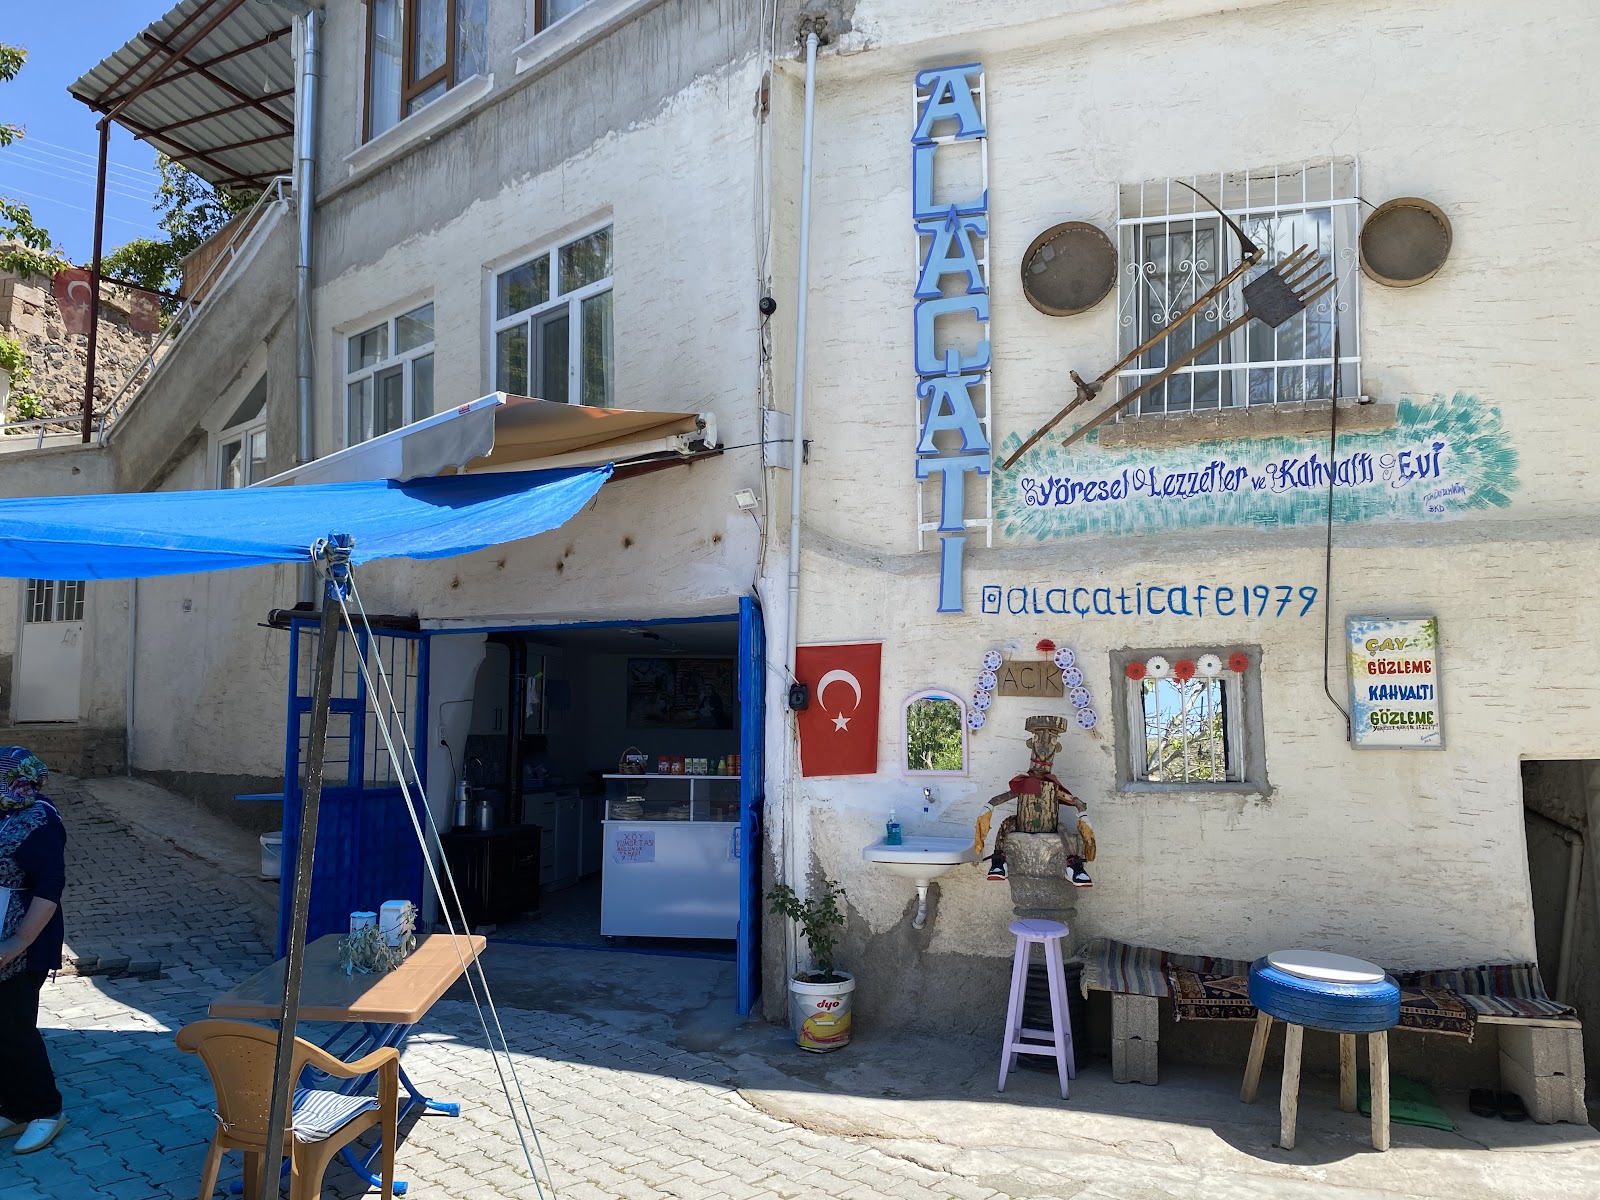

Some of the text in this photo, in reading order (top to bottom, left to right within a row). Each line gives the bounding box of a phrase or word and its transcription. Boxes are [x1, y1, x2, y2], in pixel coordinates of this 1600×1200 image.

[910, 62, 992, 613] ALAÇATI
[1033, 468, 1129, 507] Yöresel
[1142, 460, 1248, 500] Lezzetler
[1250, 475, 1267, 492] ve
[1397, 441, 1445, 481] Evi
[1365, 638, 1408, 657] ÇAY
[1367, 658, 1432, 675] GÖZLEME
[1002, 667, 1060, 691] AÇIK
[1368, 684, 1434, 701] KAHVALTI
[1370, 708, 1434, 725] GÖZLEME
[816, 999, 840, 1011] dyo
